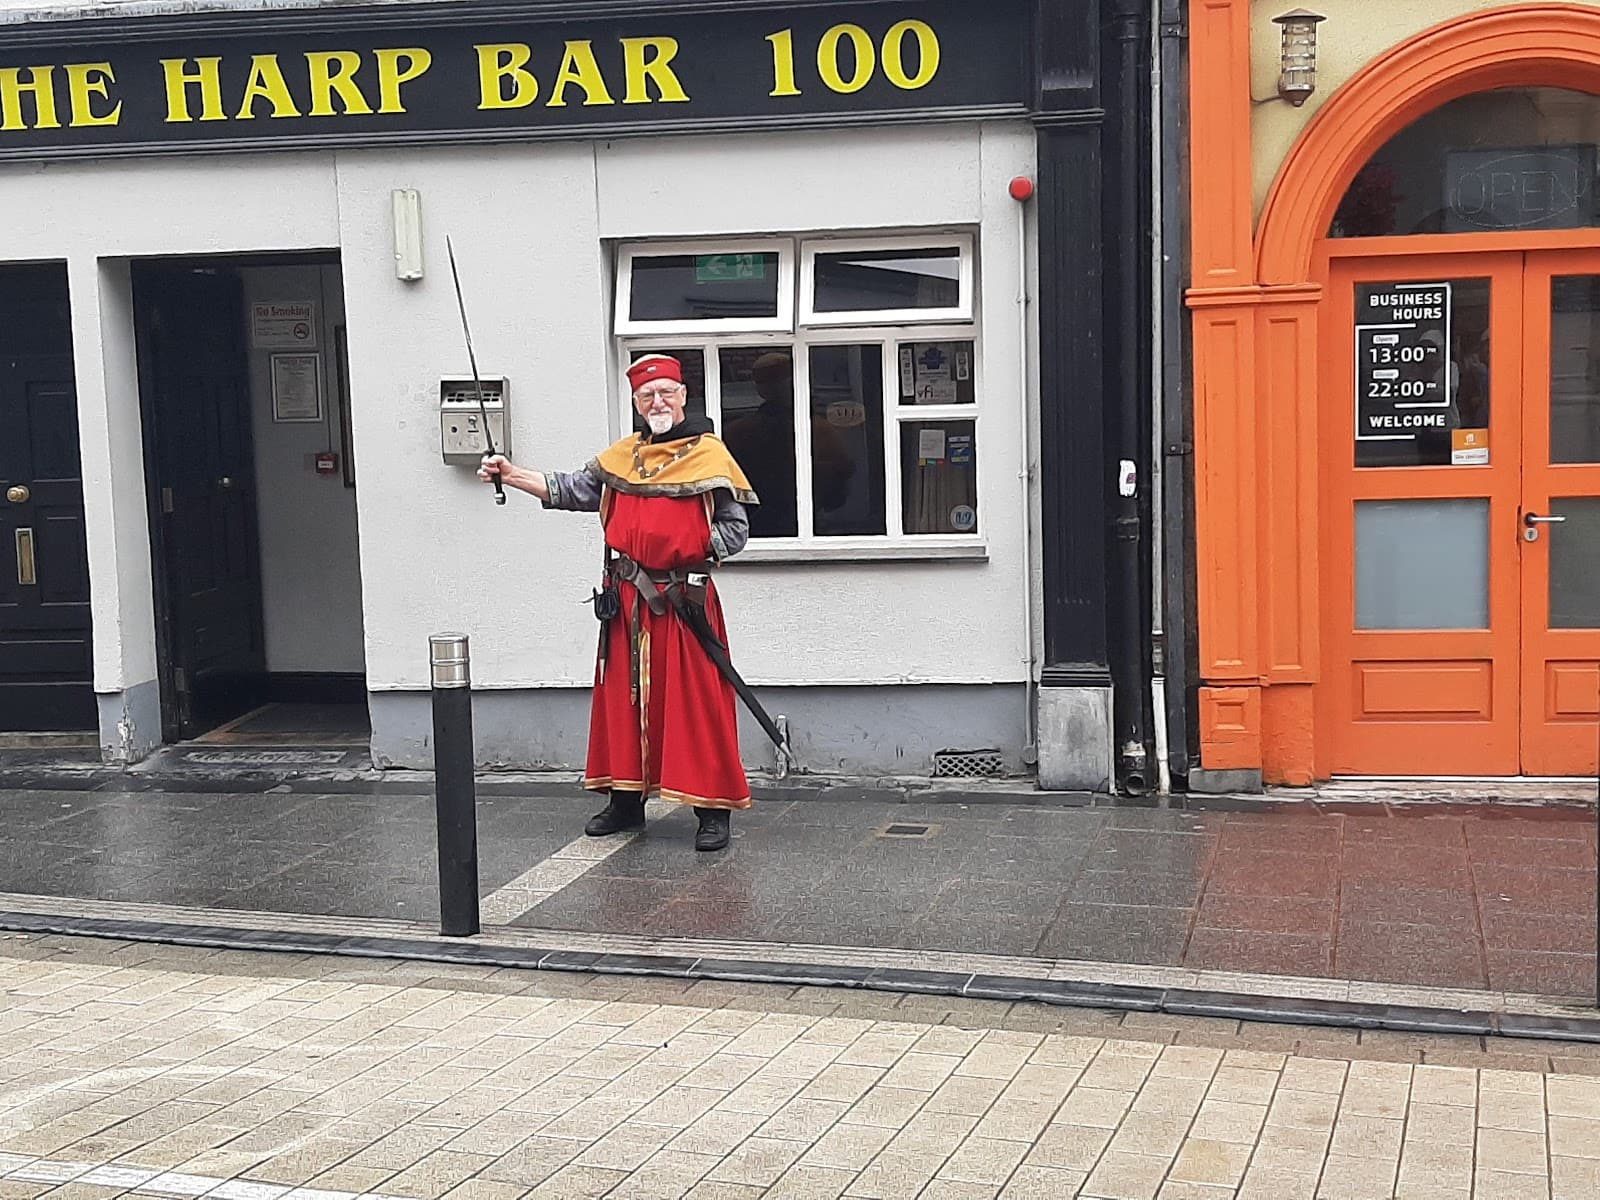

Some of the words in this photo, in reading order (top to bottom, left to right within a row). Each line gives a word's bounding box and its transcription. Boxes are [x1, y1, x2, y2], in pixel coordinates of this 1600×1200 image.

[160, 47, 433, 122] HARP
[474, 36, 690, 110] BAR
[765, 19, 941, 96] 100
[1457, 170, 1579, 216] OPEN
[1369, 291, 1443, 307] BUSINESS
[271, 304, 310, 319] Smoking
[1392, 306, 1443, 320] HOURS
[1368, 346, 1425, 363] 13:00
[1367, 380, 1425, 398] 22:00
[1368, 414, 1447, 428] WELCOME
